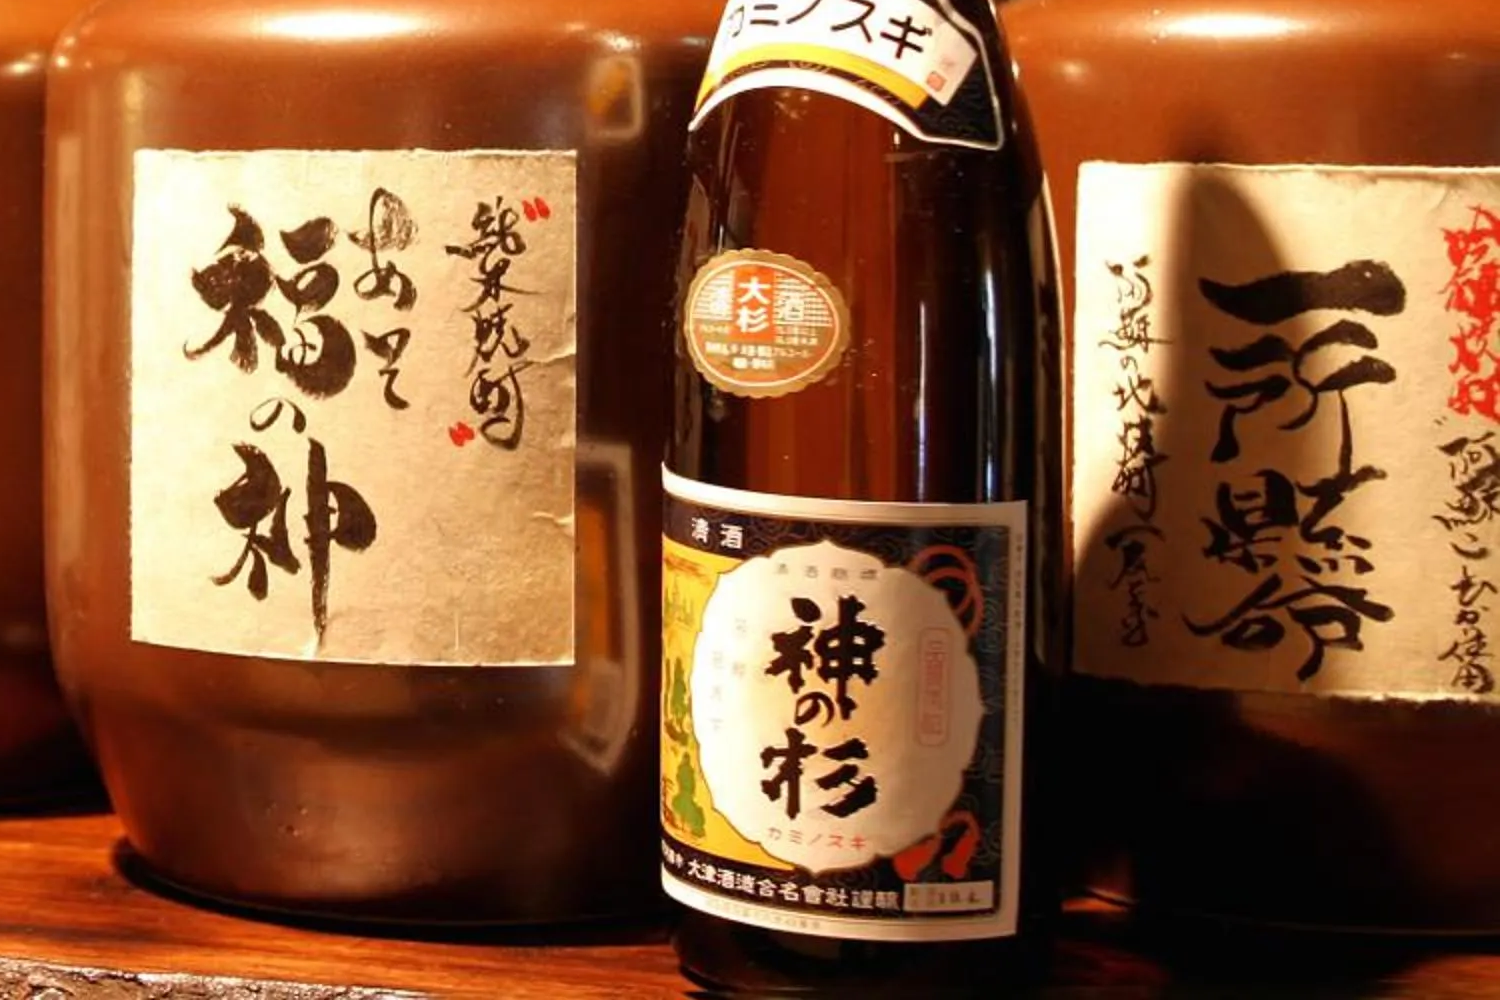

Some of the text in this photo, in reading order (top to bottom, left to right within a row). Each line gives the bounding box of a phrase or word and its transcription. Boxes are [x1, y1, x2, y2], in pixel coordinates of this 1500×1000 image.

[736, 276, 772, 333] 大杉
[759, 595, 886, 820] 神の杉
